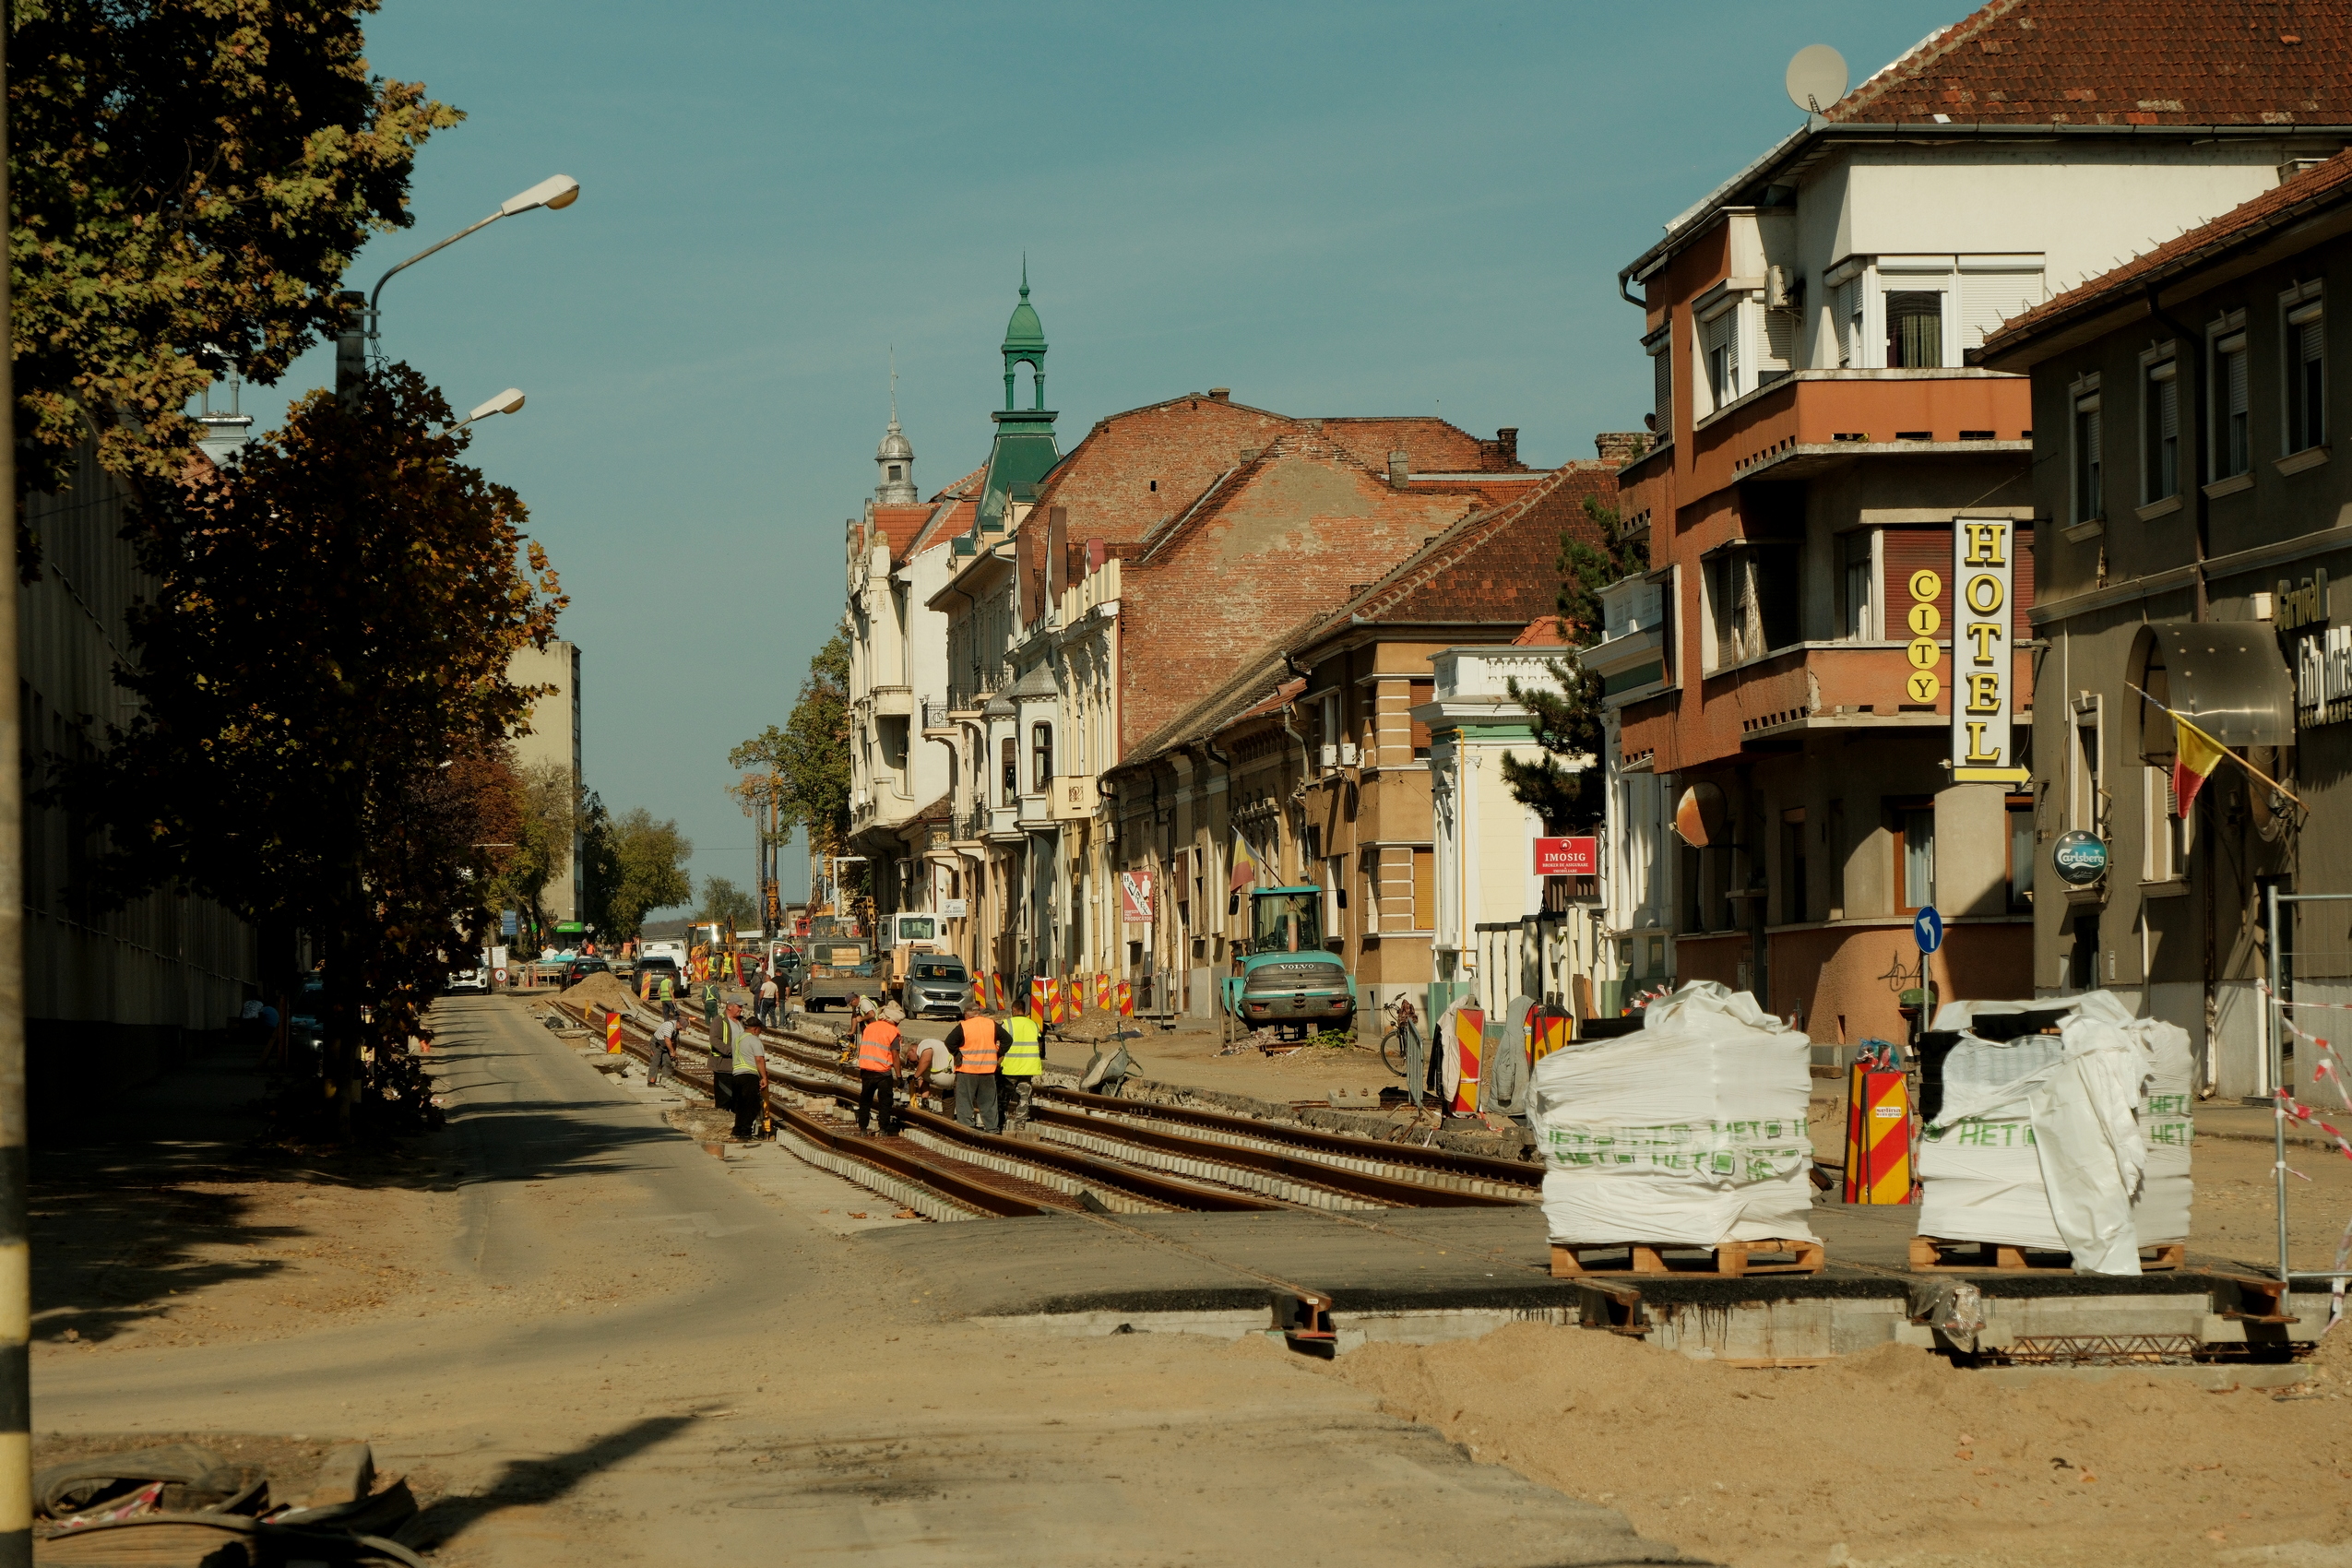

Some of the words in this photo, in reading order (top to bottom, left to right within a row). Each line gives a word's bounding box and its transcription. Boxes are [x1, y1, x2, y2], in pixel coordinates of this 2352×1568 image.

[1914, 576, 1934, 698] CITY
[1965, 524, 2006, 763] HOTEL
[1545, 853, 1586, 861] IMOSIG
[2058, 849, 2105, 866] Carlsberg
